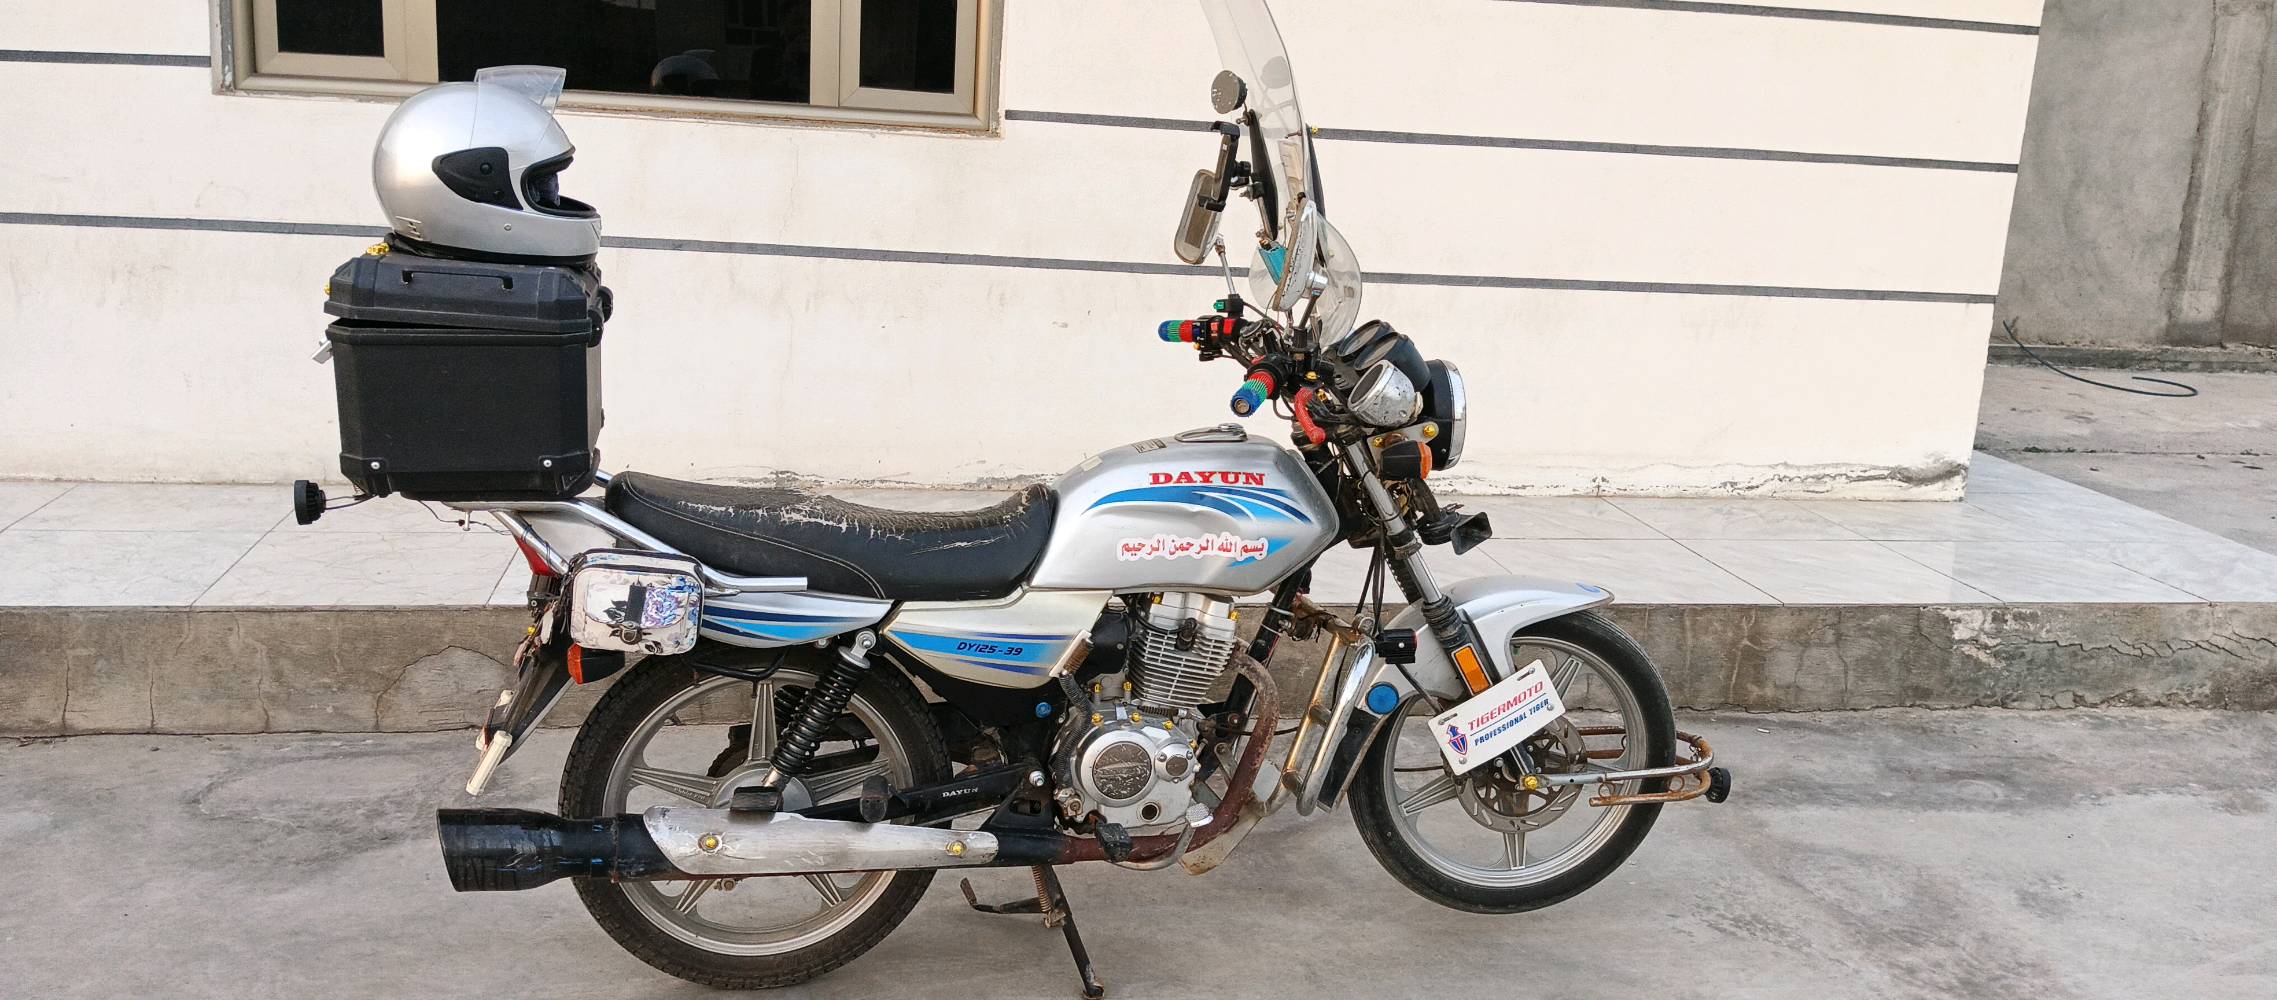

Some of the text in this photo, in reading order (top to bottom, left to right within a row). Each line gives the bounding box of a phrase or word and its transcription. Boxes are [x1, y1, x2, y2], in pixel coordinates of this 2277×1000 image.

[1149, 471, 1265, 486] DAYUN
[1121, 536, 1265, 556] بسم الله الرحمن الرحيم
[957, 641, 1023, 656] DY125-39
[1468, 681, 1544, 731] TIGERMOTO
[1475, 712, 1528, 746] PROFESSIONAL
[942, 787, 978, 797] DAYUN
